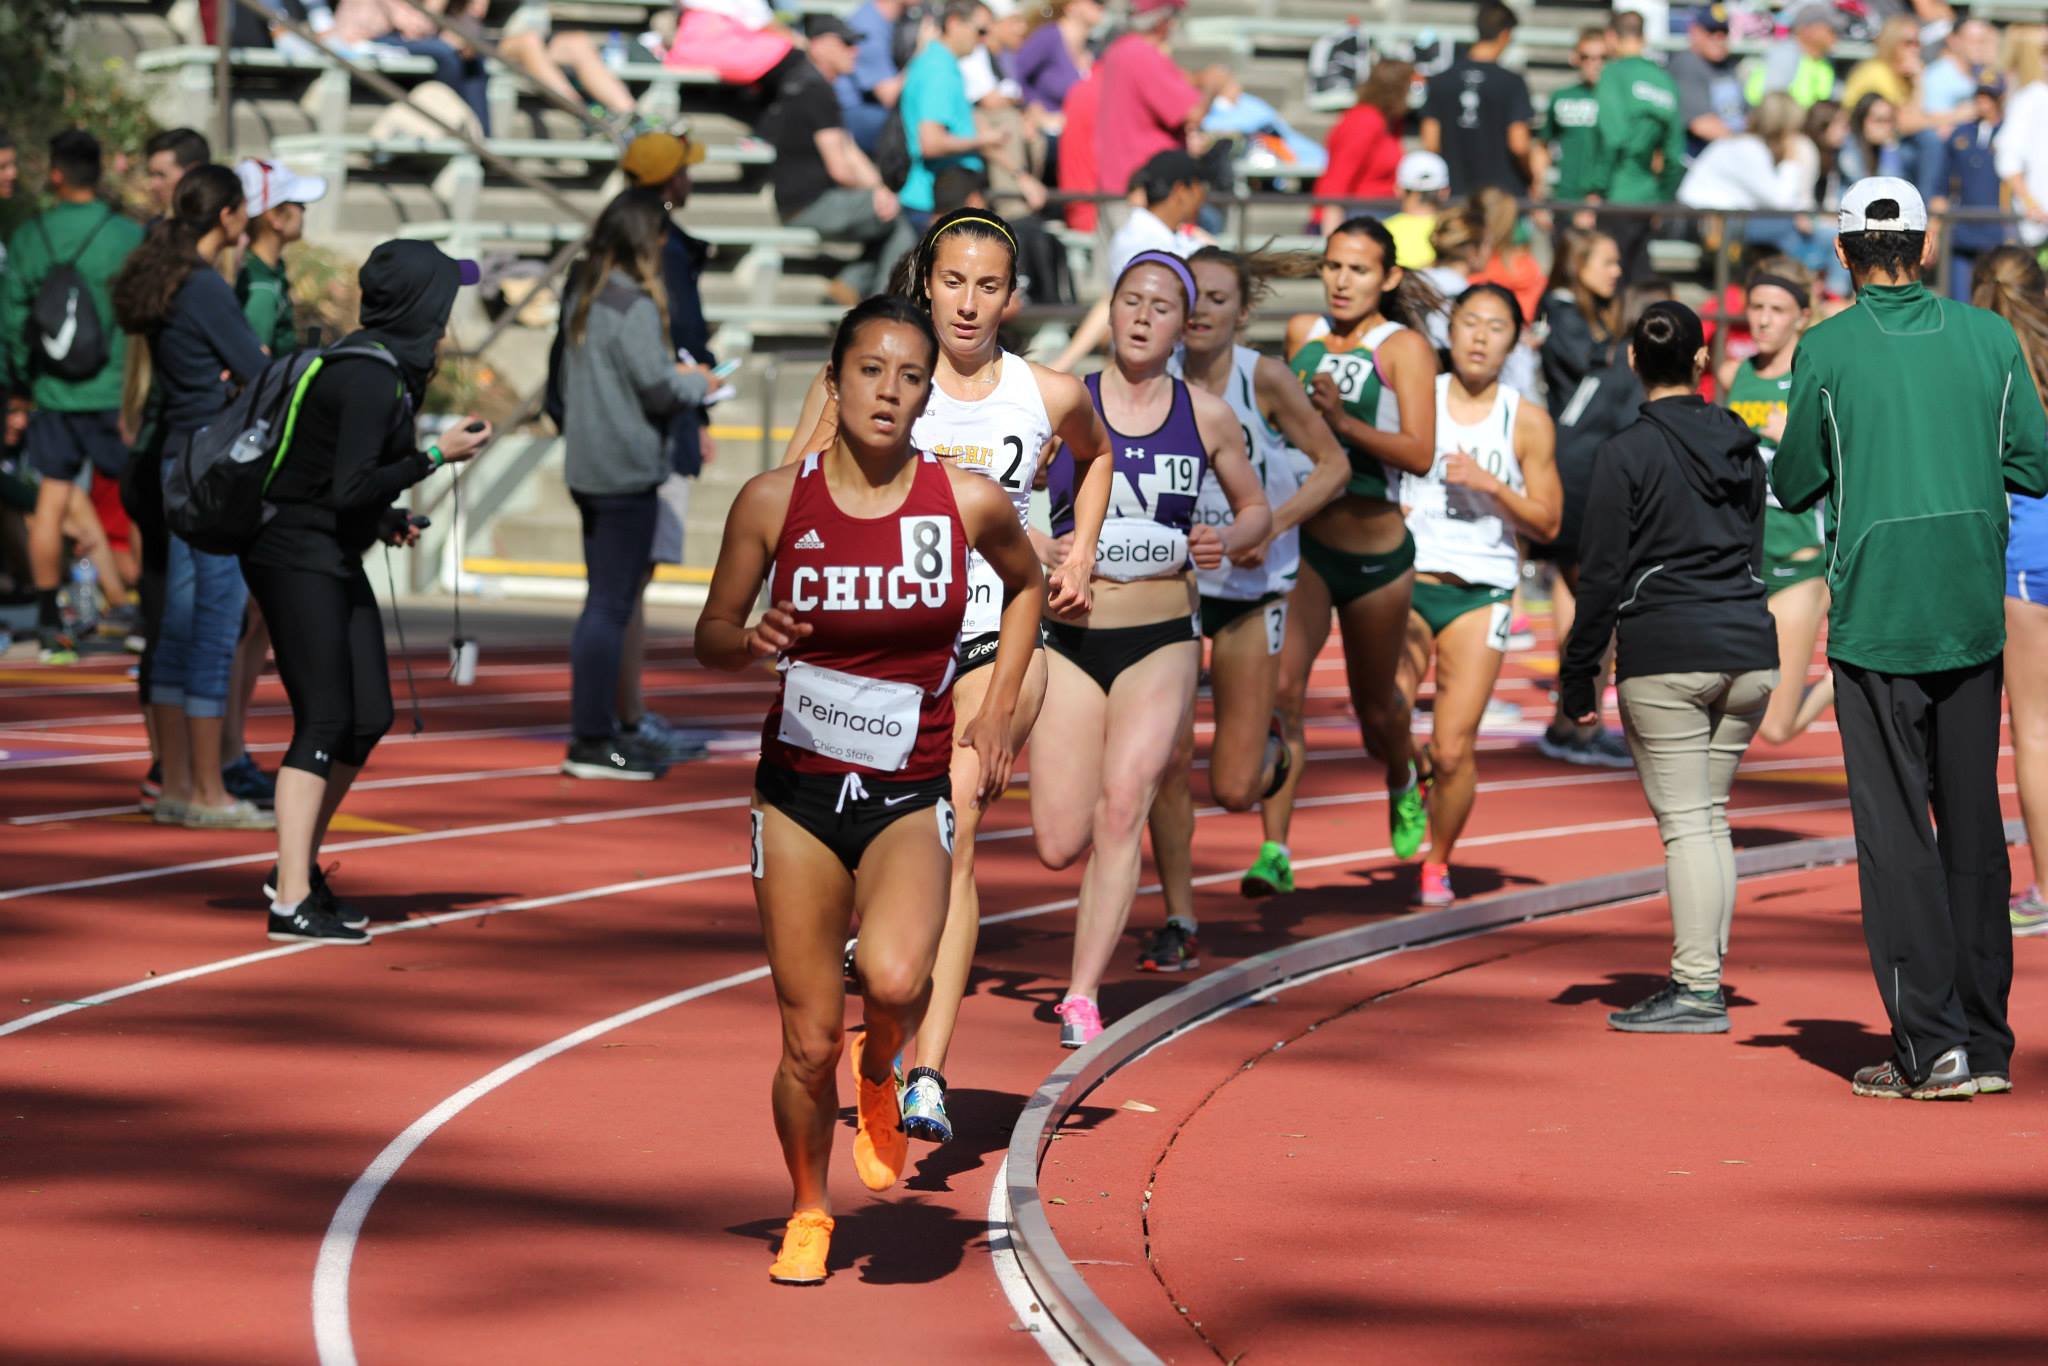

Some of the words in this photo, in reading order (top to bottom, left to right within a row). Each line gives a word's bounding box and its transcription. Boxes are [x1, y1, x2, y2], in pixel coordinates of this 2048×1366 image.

[1000, 435, 1024, 489] 2
[1165, 458, 1192, 492] 19
[913, 520, 943, 580] 8
[798, 695, 902, 737] Peinado
[812, 738, 844, 756] Chico
[846, 748, 874, 763] State
